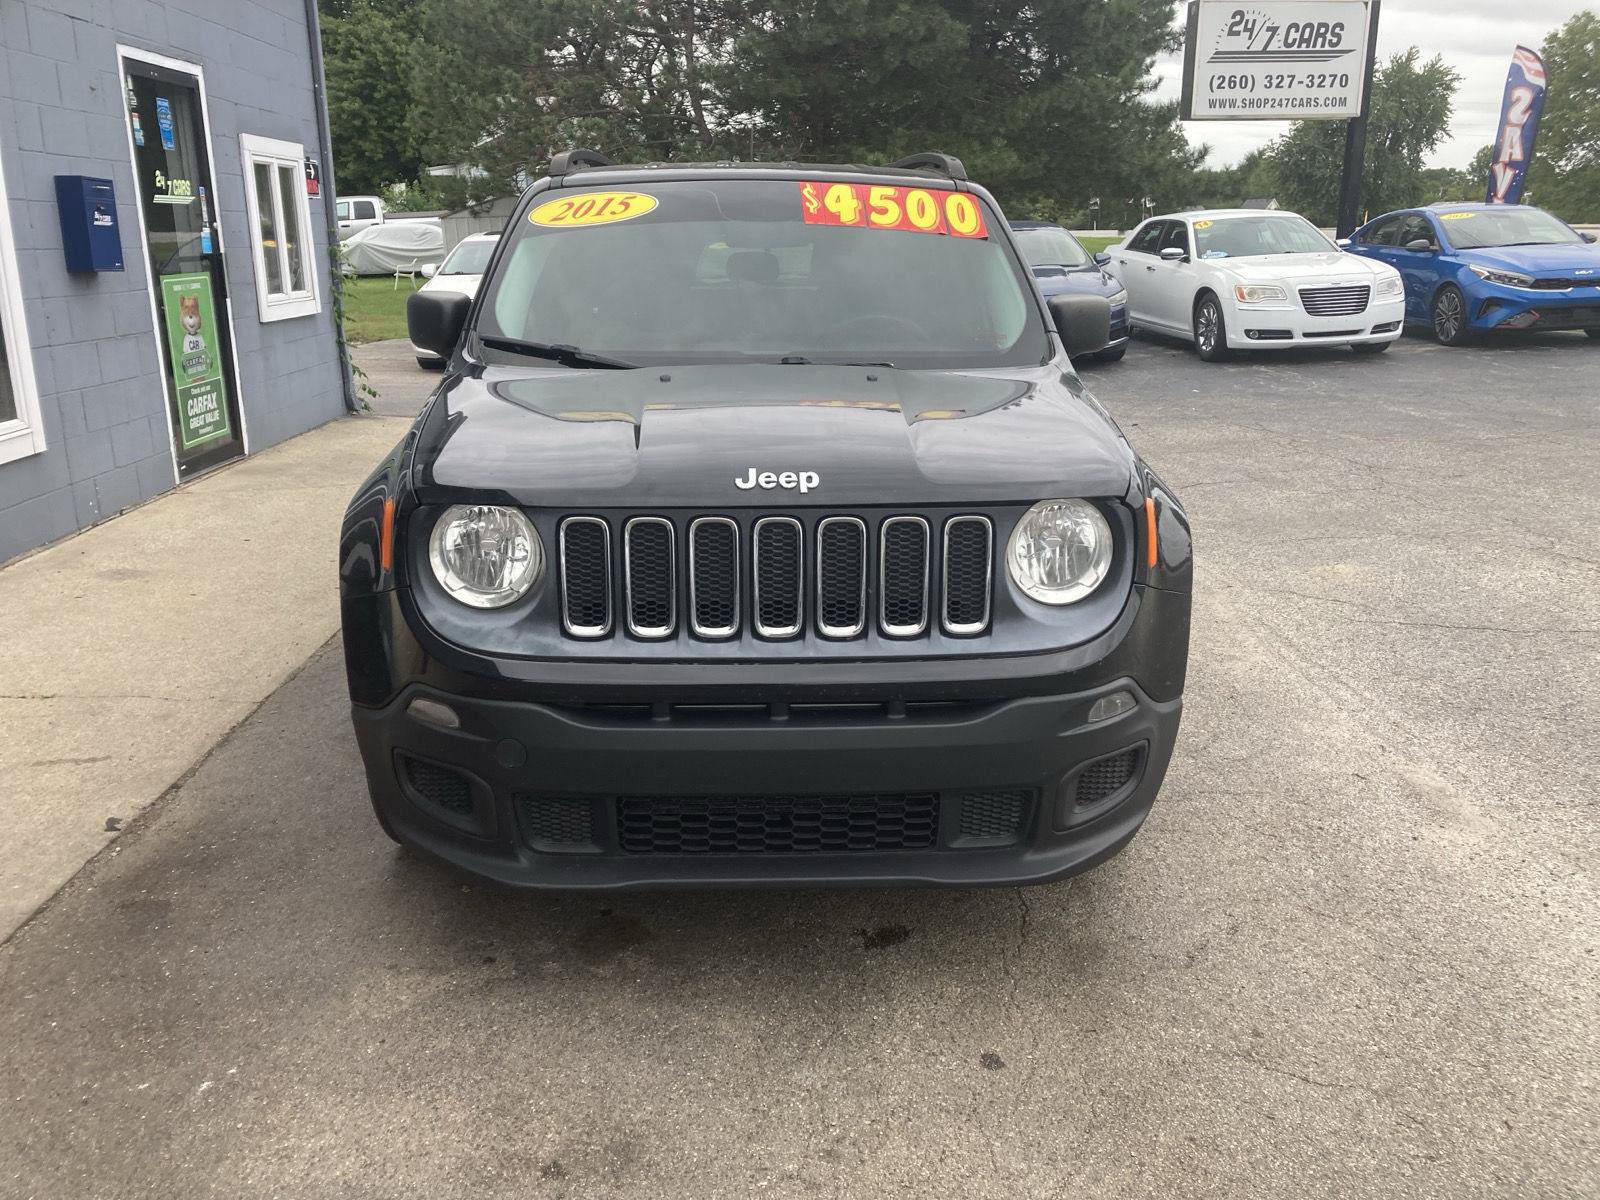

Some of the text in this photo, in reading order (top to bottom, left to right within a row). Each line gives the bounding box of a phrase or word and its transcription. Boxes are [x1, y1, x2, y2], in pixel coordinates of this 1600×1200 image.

[1282, 22, 1345, 49] CARS
[1208, 73, 1349, 93] (260) 327-3270
[1208, 97, 1347, 109] WWW.SHOP247CARS.COM
[172, 179, 192, 196] CARS
[548, 195, 638, 223] 2015
[187, 391, 218, 417] CARFAX
[734, 467, 820, 493] Jeep
